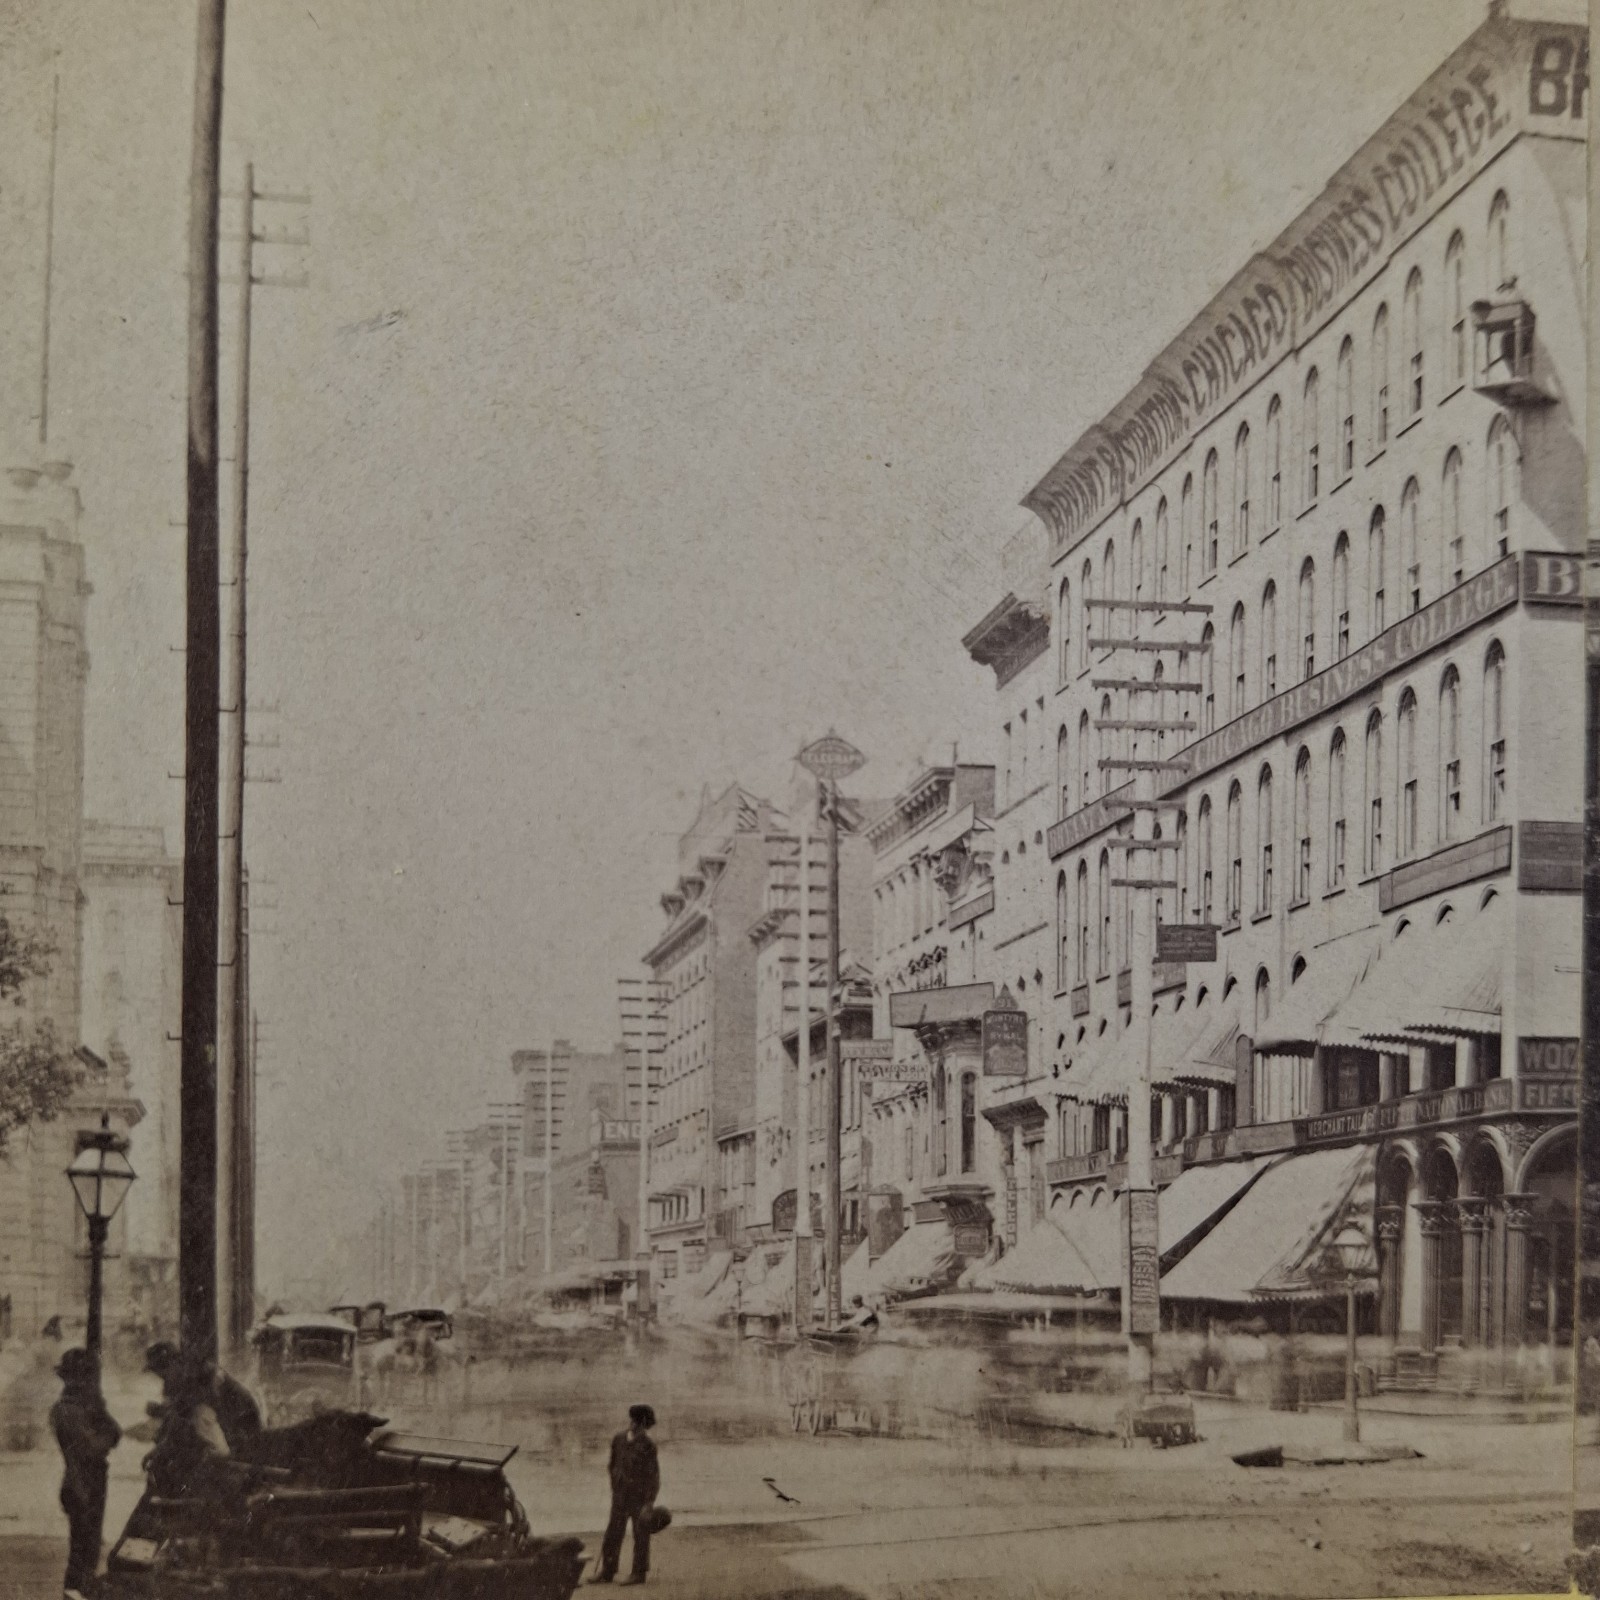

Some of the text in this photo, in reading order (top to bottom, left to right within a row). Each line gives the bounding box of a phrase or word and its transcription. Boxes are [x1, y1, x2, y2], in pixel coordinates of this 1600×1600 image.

[1045, 457, 1105, 546] BRYANT
[1182, 282, 1288, 416] CHICAGO
[1280, 188, 1384, 327] BUSINESS
[1371, 63, 1511, 233] COLLEGE
[1280, 638, 1386, 726] BUSINESS
[1308, 1114, 1348, 1138] MERCHANT
